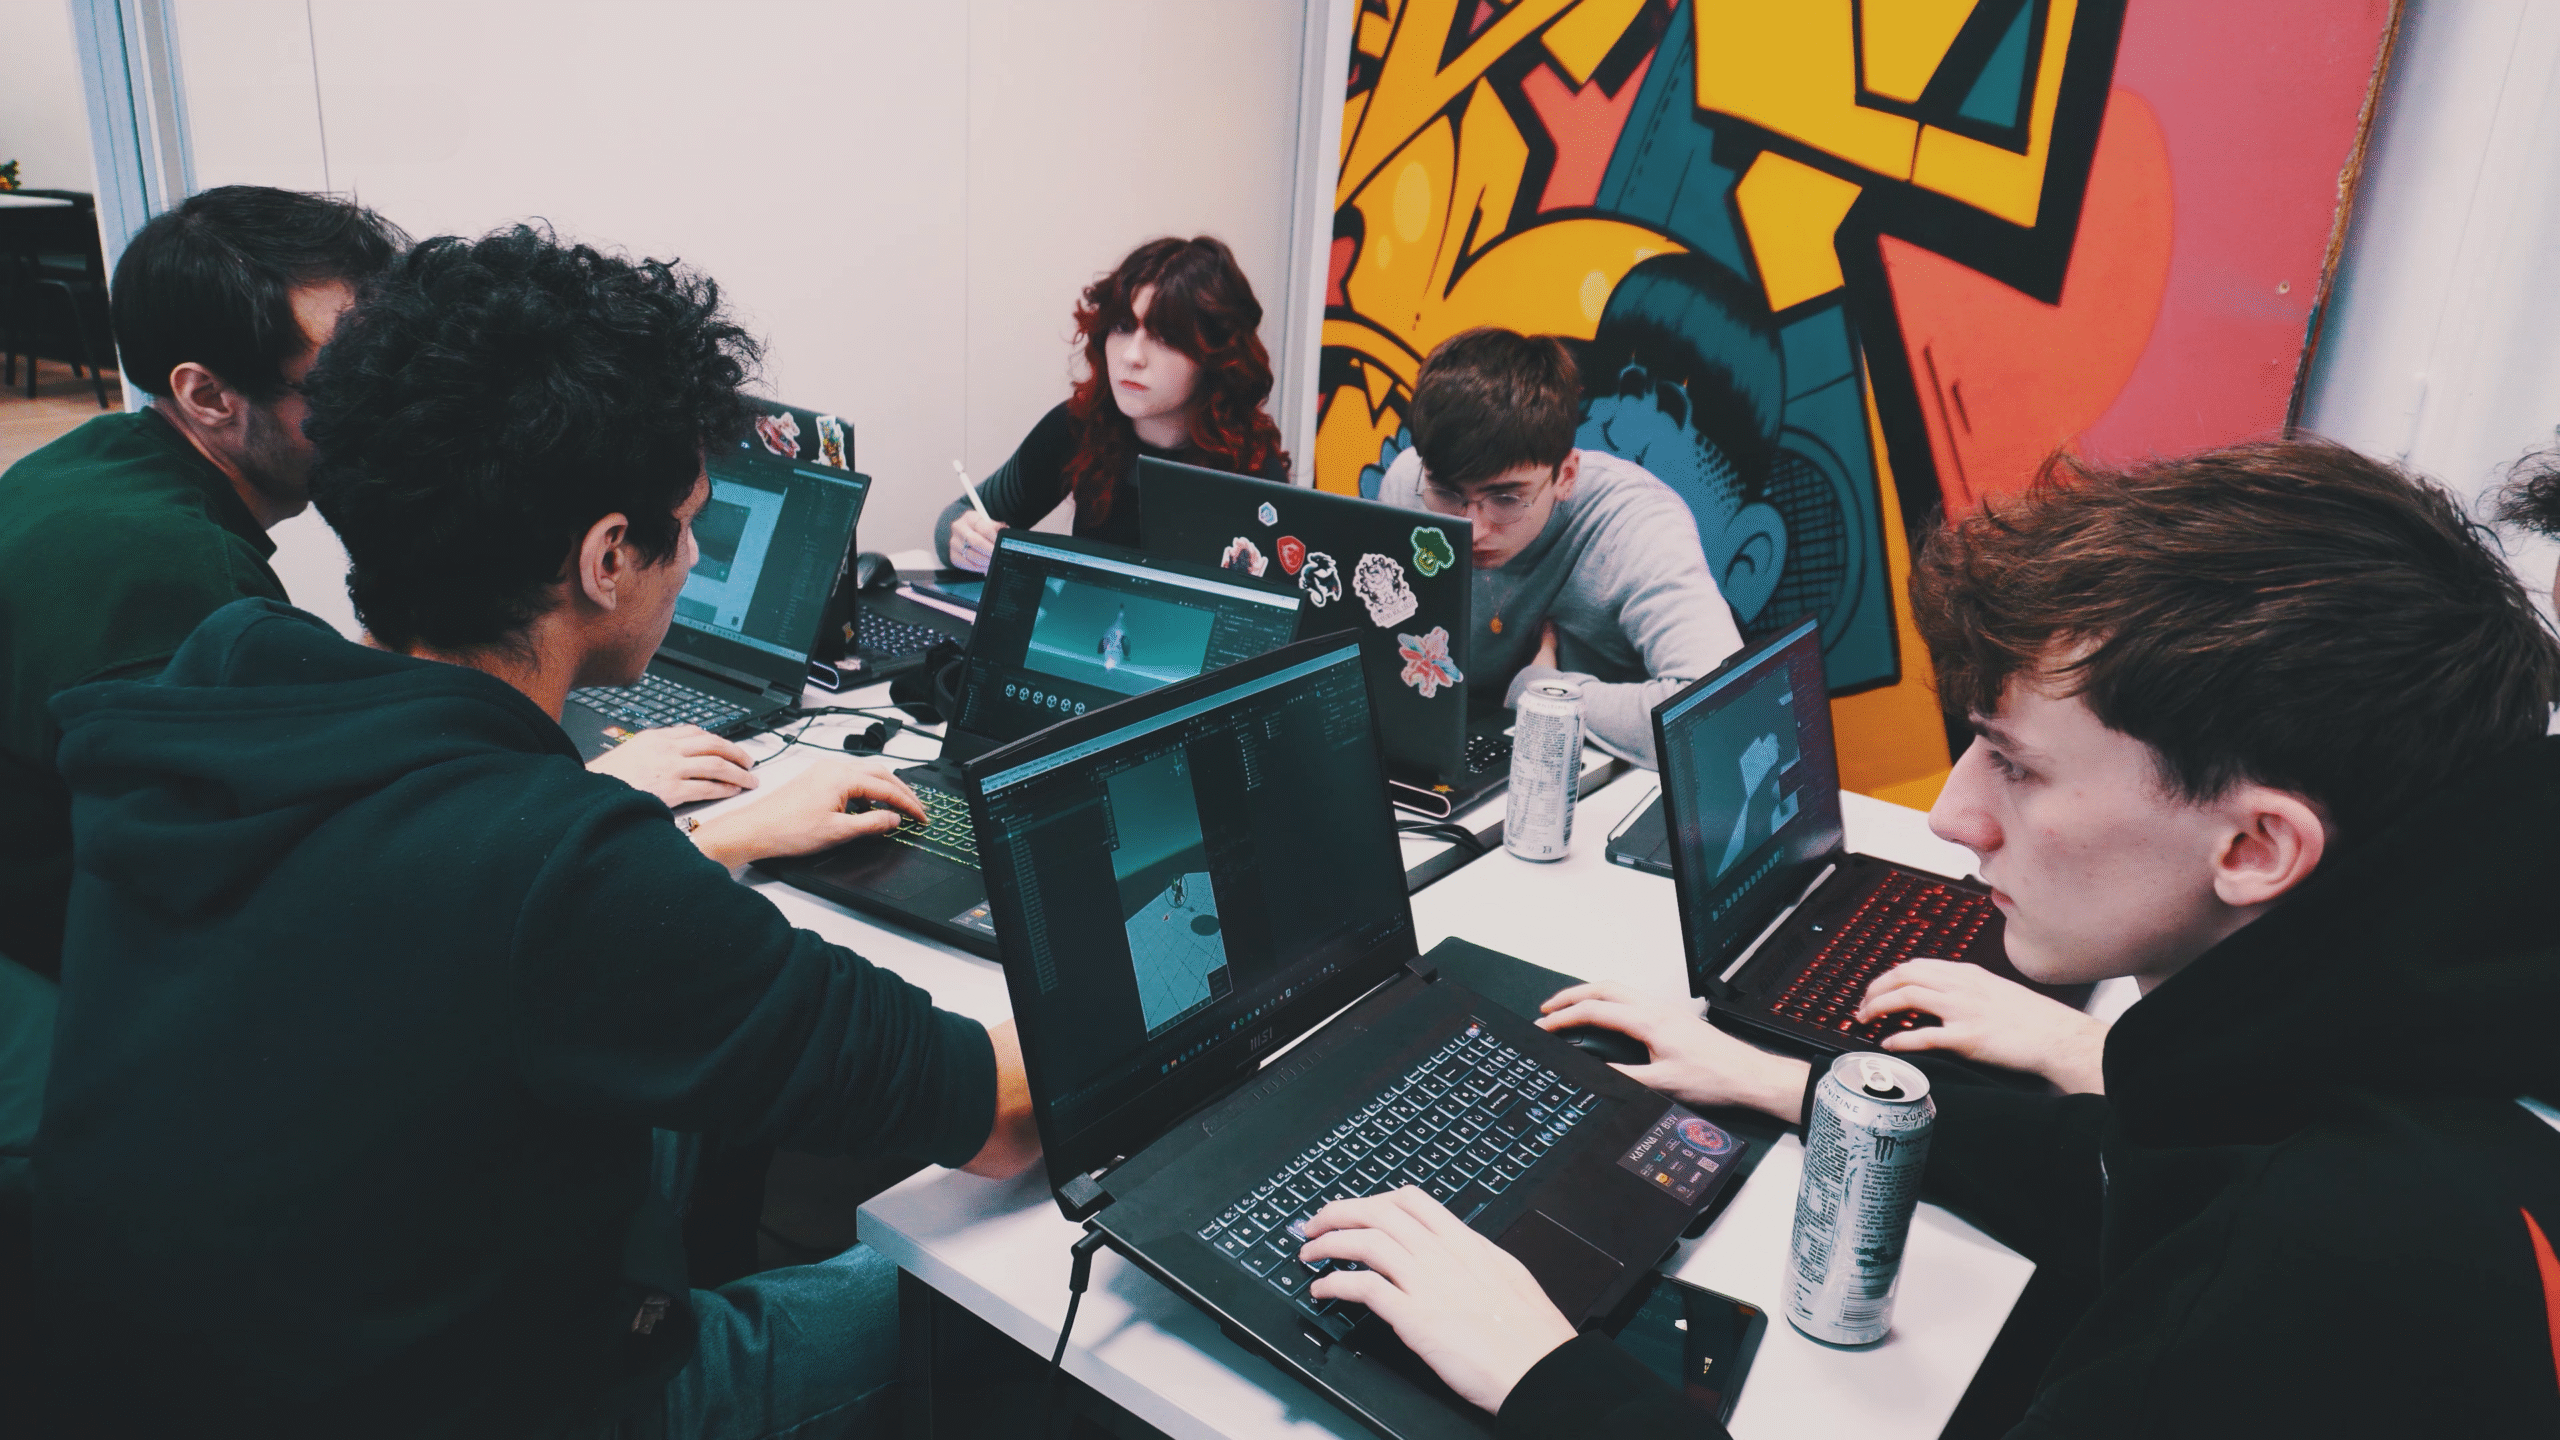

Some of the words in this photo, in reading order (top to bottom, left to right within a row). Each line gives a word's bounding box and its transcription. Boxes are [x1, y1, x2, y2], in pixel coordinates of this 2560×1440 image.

[1894, 1108, 1932, 1122] TAURIN
[1629, 1136, 1658, 1162] KATANA
[1654, 1126, 1664, 1138] 17
[1385, 1152, 1395, 1160] U
[1431, 1152, 1440, 1160] K
